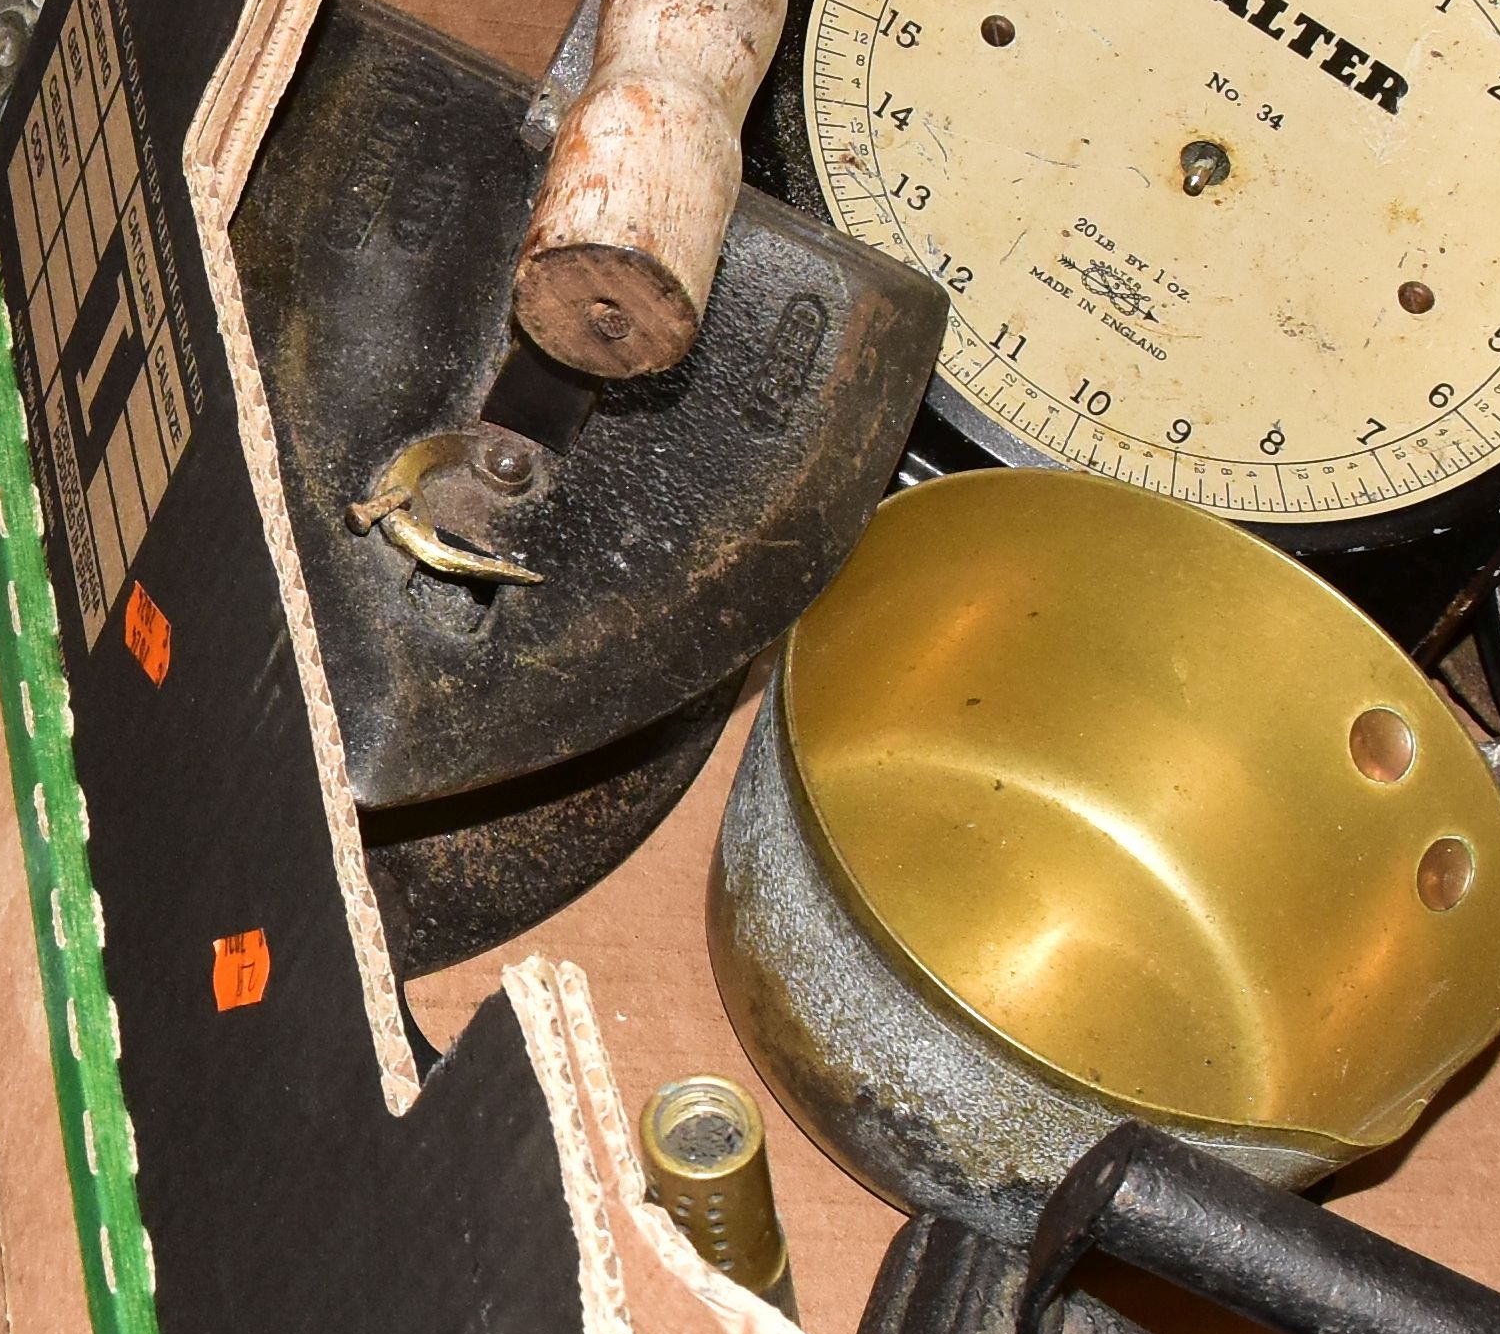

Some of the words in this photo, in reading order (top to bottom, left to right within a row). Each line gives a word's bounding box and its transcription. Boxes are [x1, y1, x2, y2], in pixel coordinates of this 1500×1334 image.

[853, 30, 868, 44] 12
[879, 9, 922, 48] 15
[68, 26, 83, 87] GEM
[856, 55, 865, 66] 8
[851, 78, 860, 88] 4
[873, 91, 913, 131] 14
[1205, 72, 1243, 106] No.
[1257, 104, 1284, 130] 34
[49, 74, 71, 168] CELERY
[850, 122, 864, 133] 12
[30, 121, 45, 179] COS
[860, 144, 869, 155] 8
[890, 173, 931, 210] 13
[892, 233, 902, 244] 8
[127, 205, 157, 329] CAT/CLASS
[141, 136, 161, 205] KEEP
[155, 207, 204, 416] REFRIGERATED
[937, 253, 973, 295] 12
[1100, 261, 1141, 292] SALTER
[1125, 254, 1149, 271] BY
[1153, 269, 1165, 284] 1
[1029, 266, 1073, 298] MADE
[1078, 298, 1096, 314] IN
[1101, 313, 1167, 360] ENGLAND
[75, 270, 134, 437] I
[967, 338, 977, 347] 4
[989, 323, 1026, 362] 11
[1002, 373, 1017, 387] 12
[153, 344, 183, 451] CAL/SIZE
[1025, 388, 1037, 399] 8
[1070, 378, 1111, 416] 10
[1429, 383, 1454, 408] 6
[1474, 399, 1489, 412] 12
[1048, 406, 1059, 414] 4
[1092, 429, 1105, 441] 12
[1166, 419, 1191, 443] 9
[1260, 429, 1285, 455] 8
[1356, 418, 1387, 445] 7
[1416, 438, 1428, 447] 8
[56, 394, 80, 509] PRODUCIDO
[1119, 441, 1130, 450] 8
[1392, 447, 1406, 460] 12
[1194, 463, 1205, 473] 12
[1296, 469, 1309, 479] 12
[52, 425, 75, 532] PRODUCED
[74, 551, 91, 616] SPAIN
